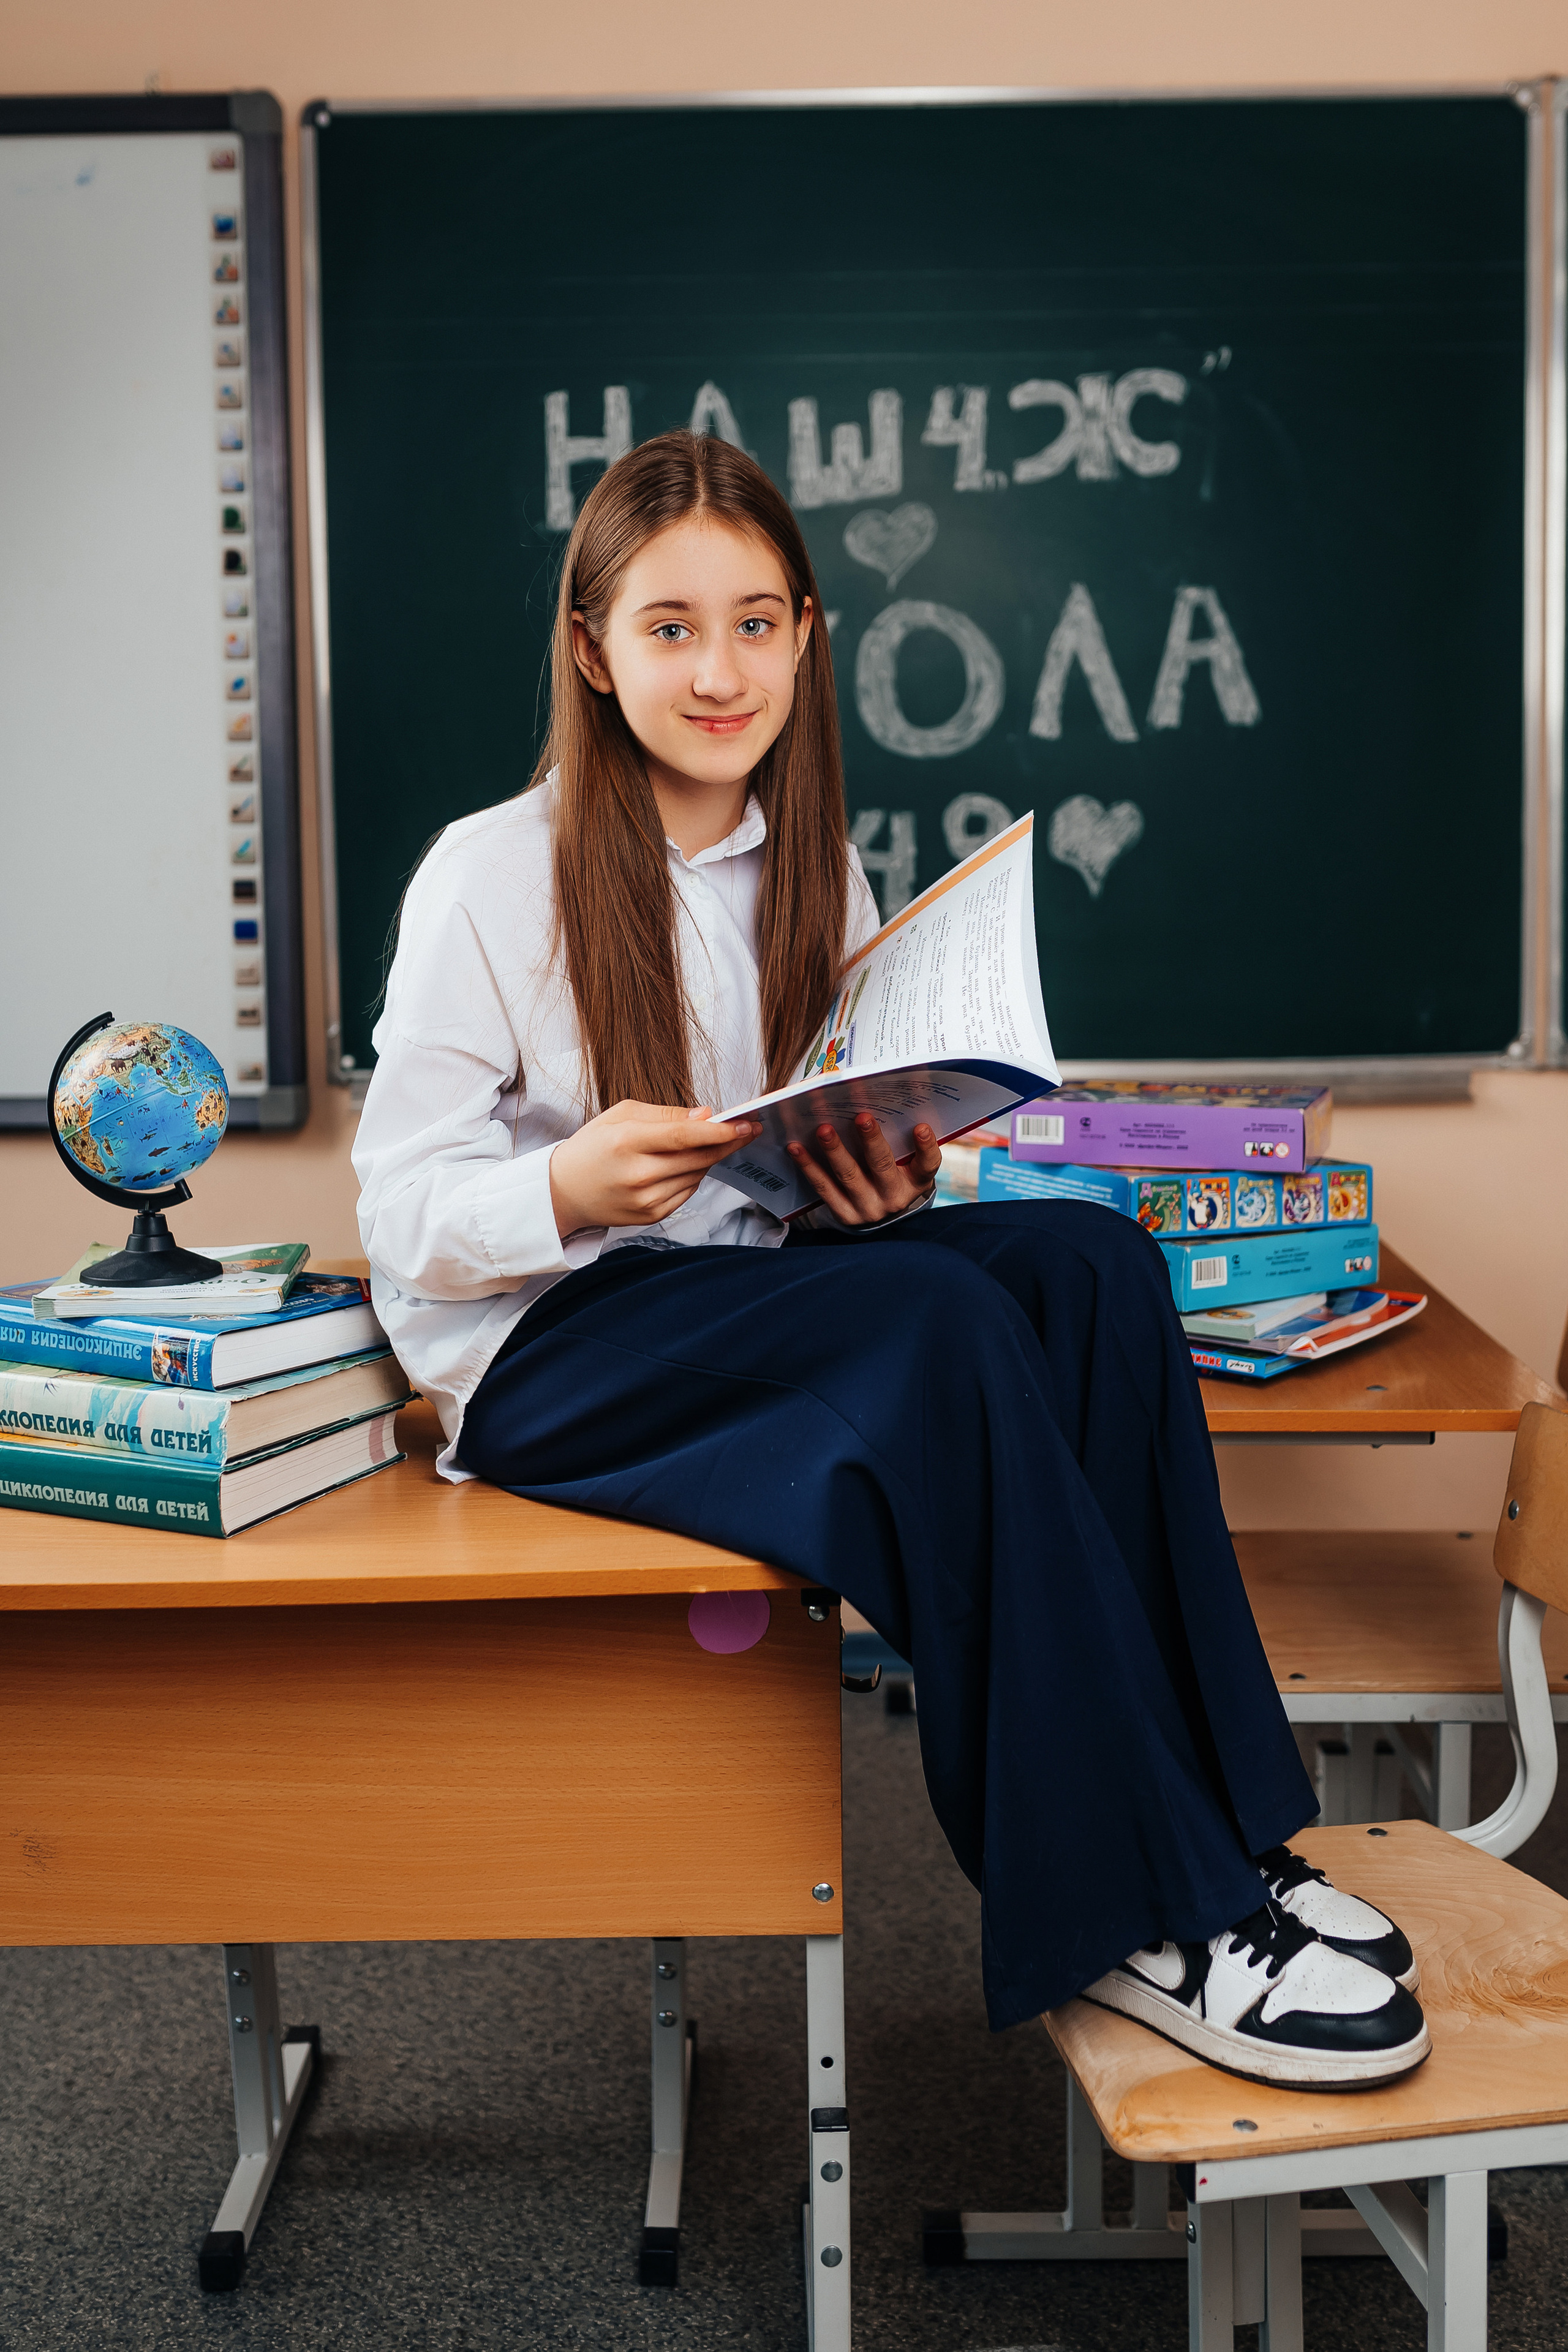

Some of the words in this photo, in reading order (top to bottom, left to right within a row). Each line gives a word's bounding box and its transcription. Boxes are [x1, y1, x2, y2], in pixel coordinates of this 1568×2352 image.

[827, 583, 1262, 760] ОЛА
[962, 986, 967, 996] Не
[881, 976, 893, 1040] доброжелательный
[971, 1017, 975, 1026] по
[1006, 1006, 1020, 1049] выслушай
[31, 1329, 143, 1361] ЭНЦИКЛОПЕДИЯ
[192, 1337, 202, 1382] ИСКУССТВО
[104, 1422, 142, 1445] ДЛЯ
[150, 1427, 213, 1454] ДЕТЕЙ
[115, 1494, 149, 1513] ДЛЯ
[156, 1501, 210, 1521] ДЕТЕЙ
